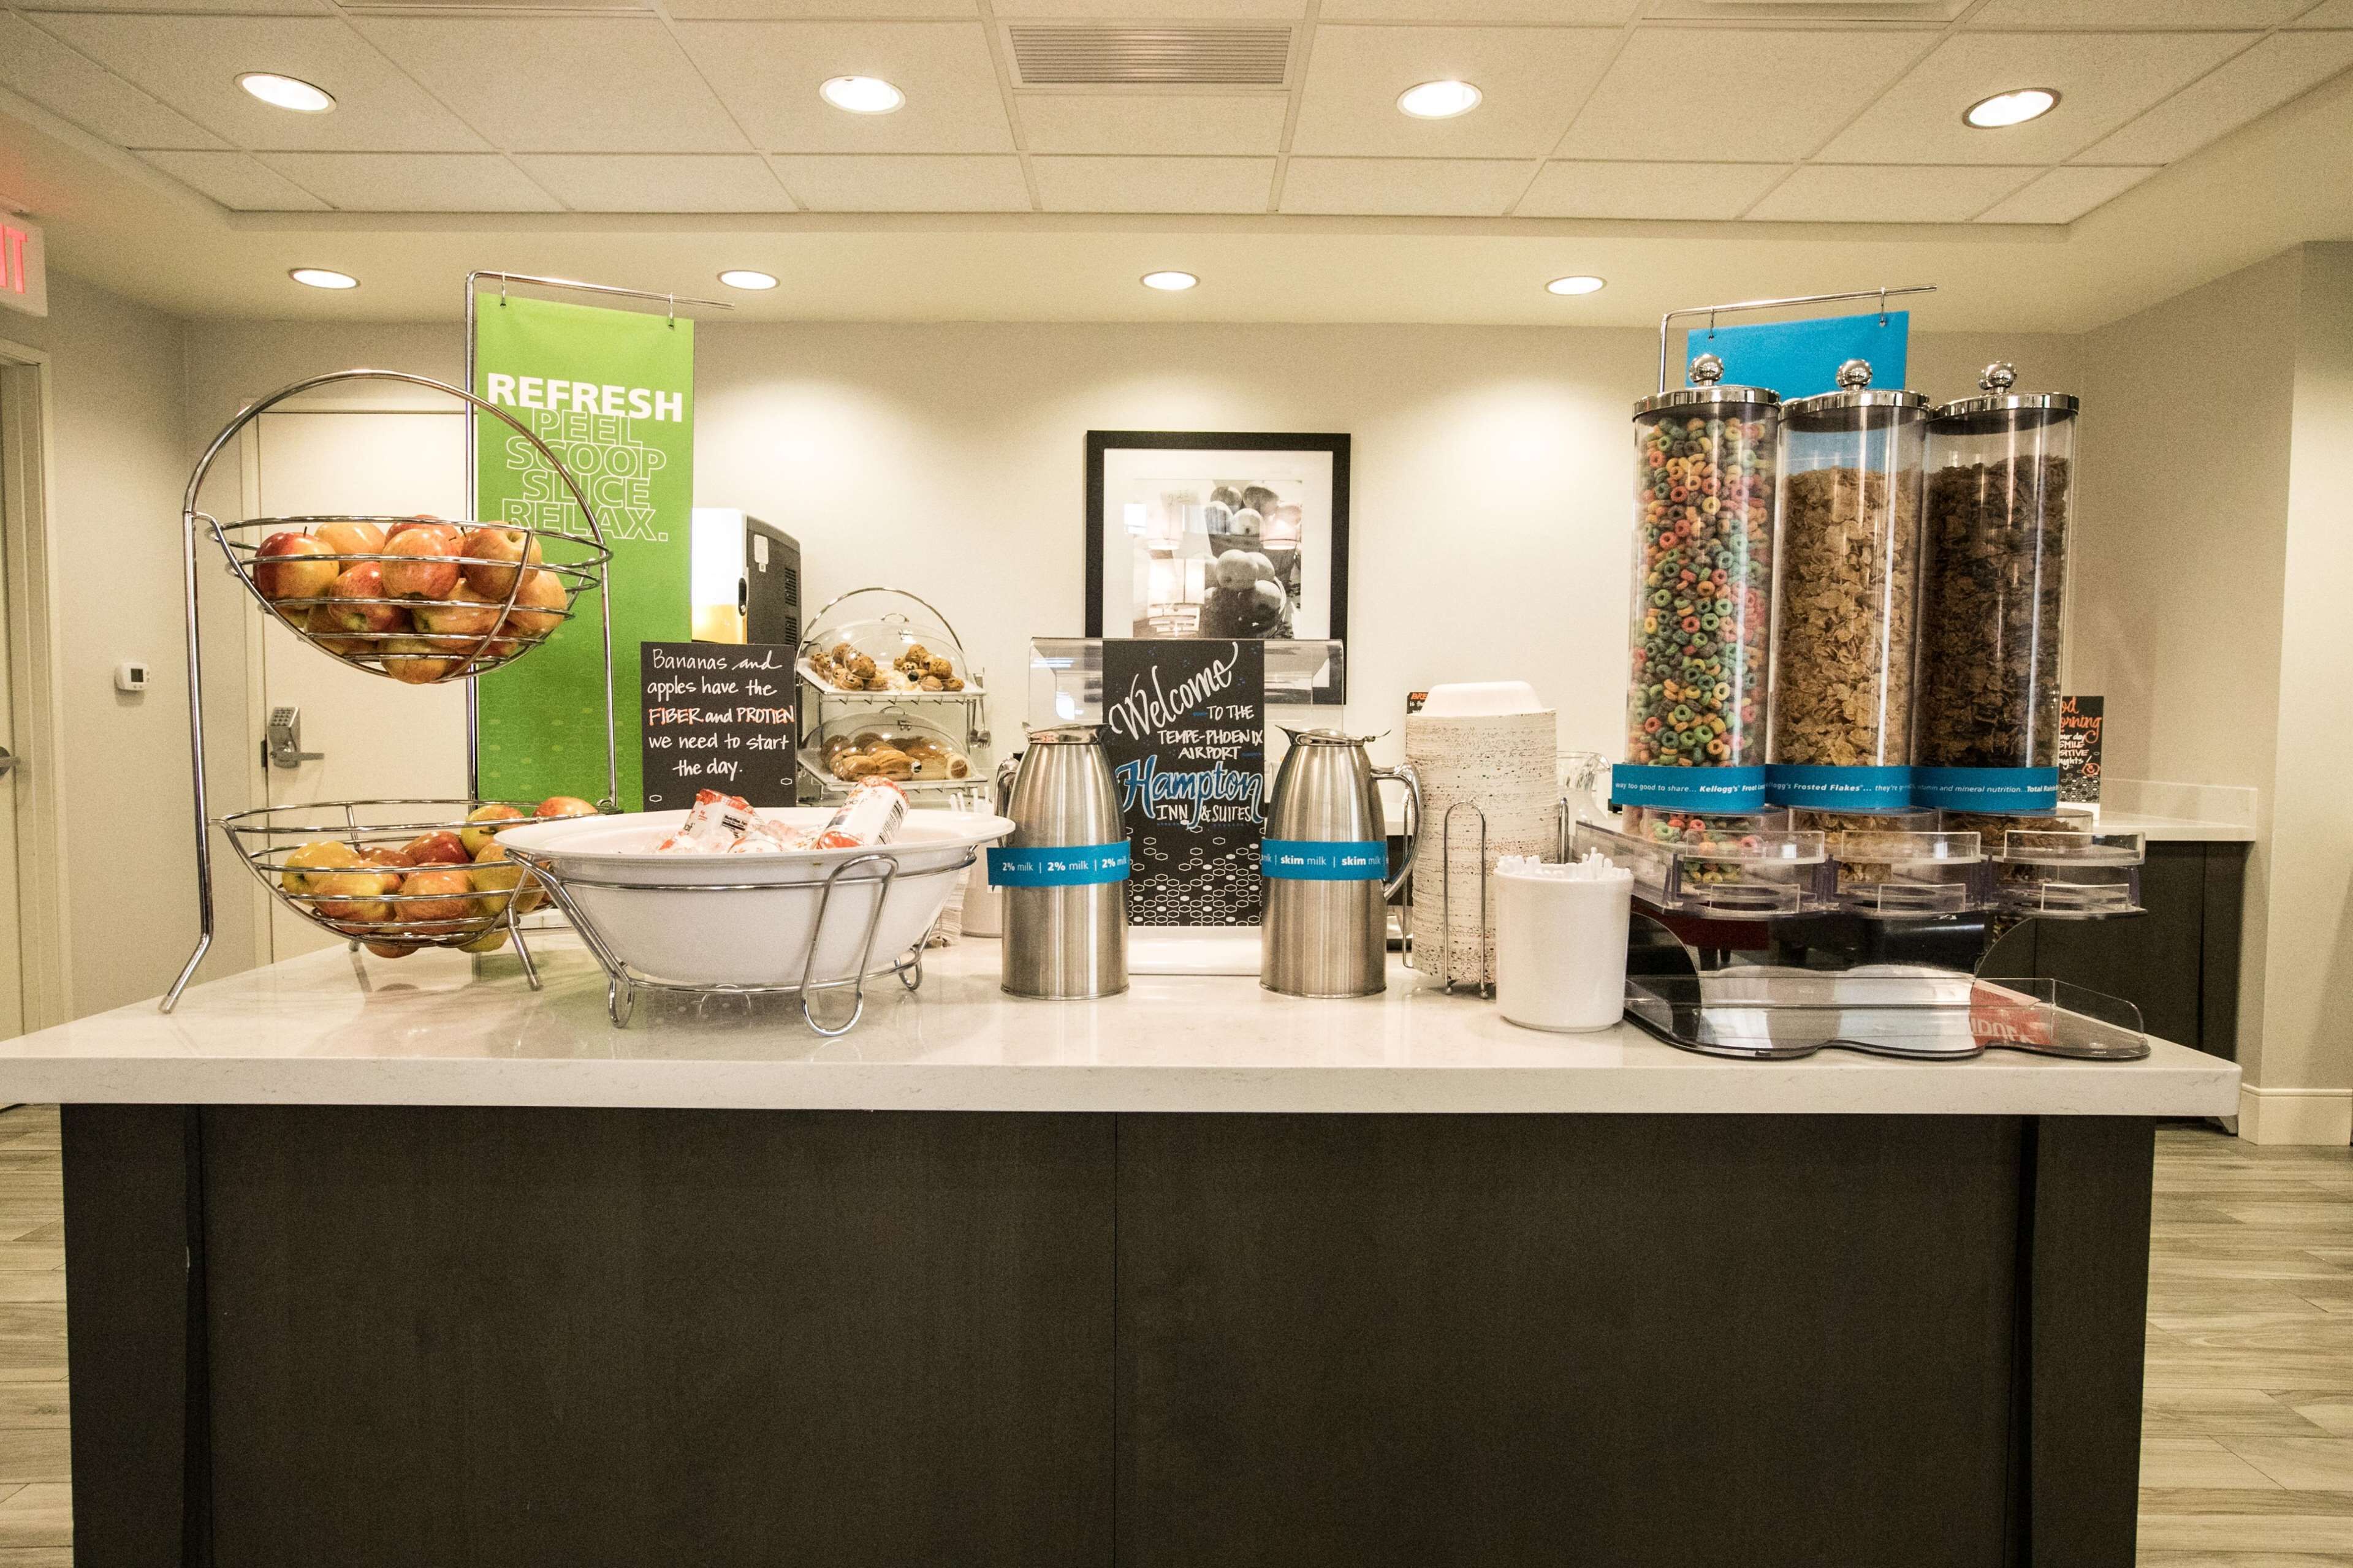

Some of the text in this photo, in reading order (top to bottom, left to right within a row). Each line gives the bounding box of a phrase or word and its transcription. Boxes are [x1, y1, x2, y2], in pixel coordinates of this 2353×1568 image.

[0, 222, 28, 294] IT
[487, 372, 682, 422] REFRESH
[532, 407, 643, 449] PEEL
[506, 436, 666, 479] SCOOP
[522, 469, 650, 510] SLICE
[502, 498, 668, 542] RELAX.
[653, 648, 783, 670] Bananas and
[647, 675, 777, 702] apples have the
[1108, 642, 1239, 740] Welcome
[648, 705, 795, 725] FIBER and PROTIEN
[1207, 705, 1255, 720] TO THE
[1157, 730, 1264, 746] TEMPE-PHOENIX
[2060, 715, 2102, 743] orning
[648, 732, 789, 750] we need to start
[1178, 746, 1242, 760] AIRPORT
[672, 758, 743, 781] the day.
[1115, 754, 1265, 830] Hampton
[1765, 781, 1792, 791] ellogg's
[1156, 805, 1188, 820] INN
[1002, 862, 1033, 871] 2% milk
[1047, 860, 1089, 871] 2% milk
[1101, 857, 1116, 868] 2%
[1280, 855, 1327, 865] skim milk
[1341, 856, 1366, 865] skim
